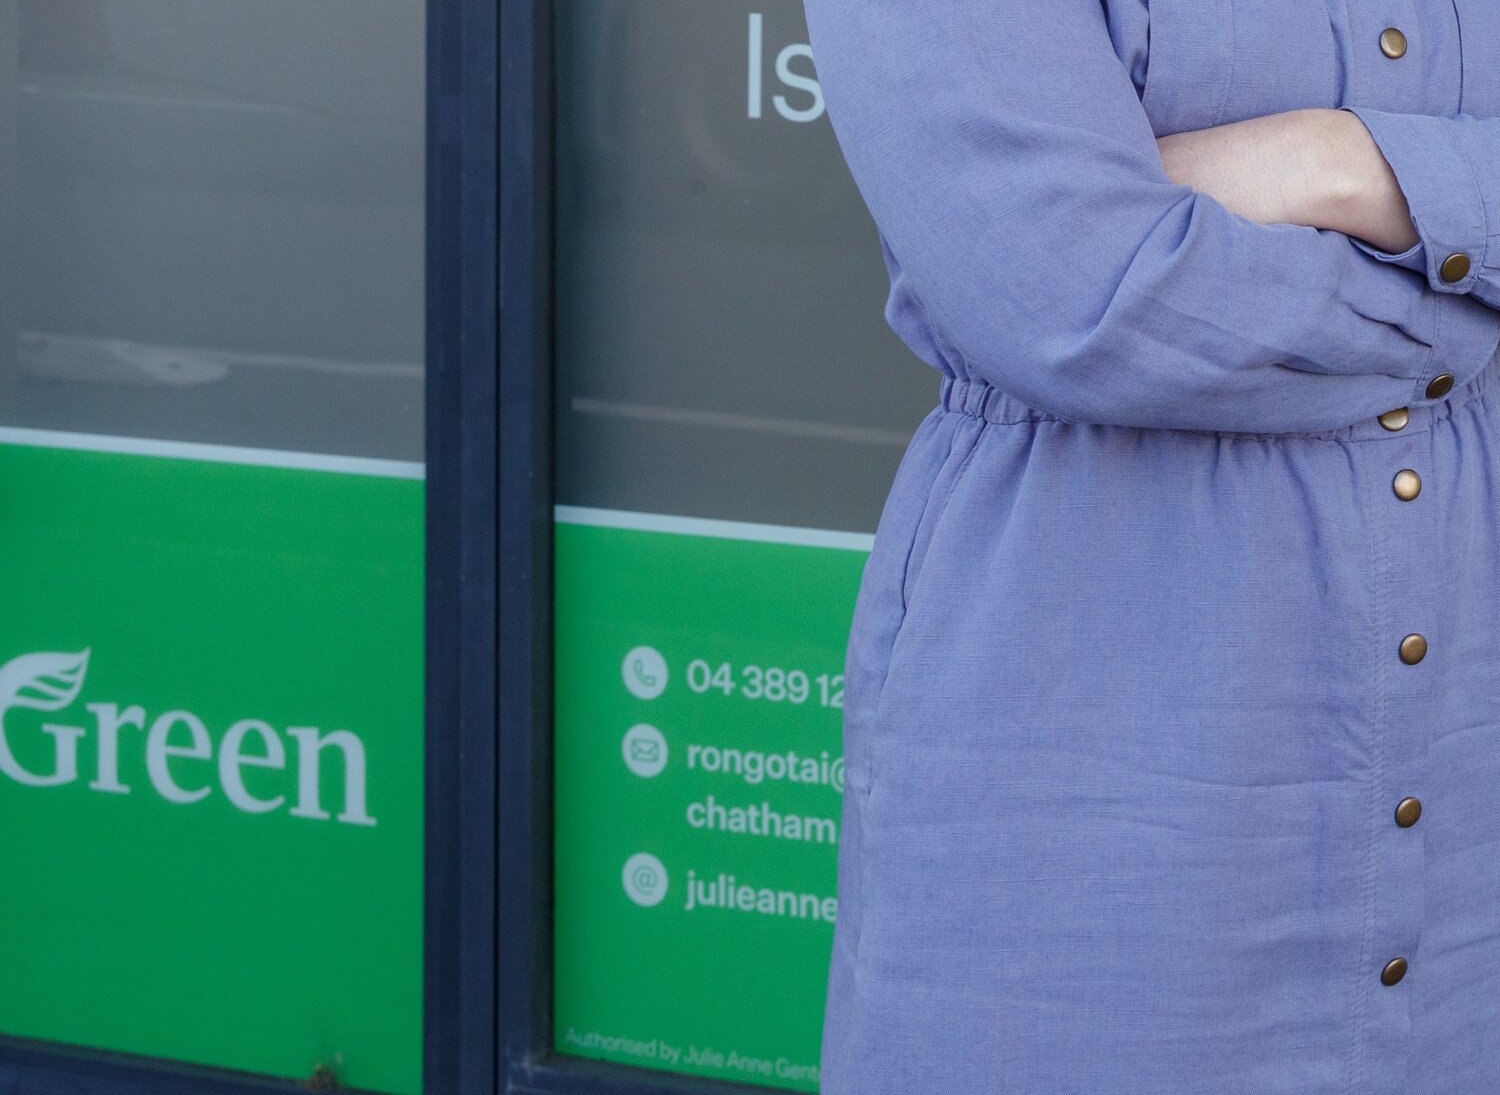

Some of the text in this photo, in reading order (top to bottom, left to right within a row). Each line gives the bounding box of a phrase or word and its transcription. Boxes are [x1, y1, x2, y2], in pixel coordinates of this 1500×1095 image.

[686, 658, 736, 697] 04
[741, 664, 810, 705] 389
[0, 646, 377, 827] Green
[686, 794, 837, 845] chatham
[684, 869, 840, 923] julieanne
[659, 1038, 681, 1065] by
[725, 1048, 773, 1076] Anne
